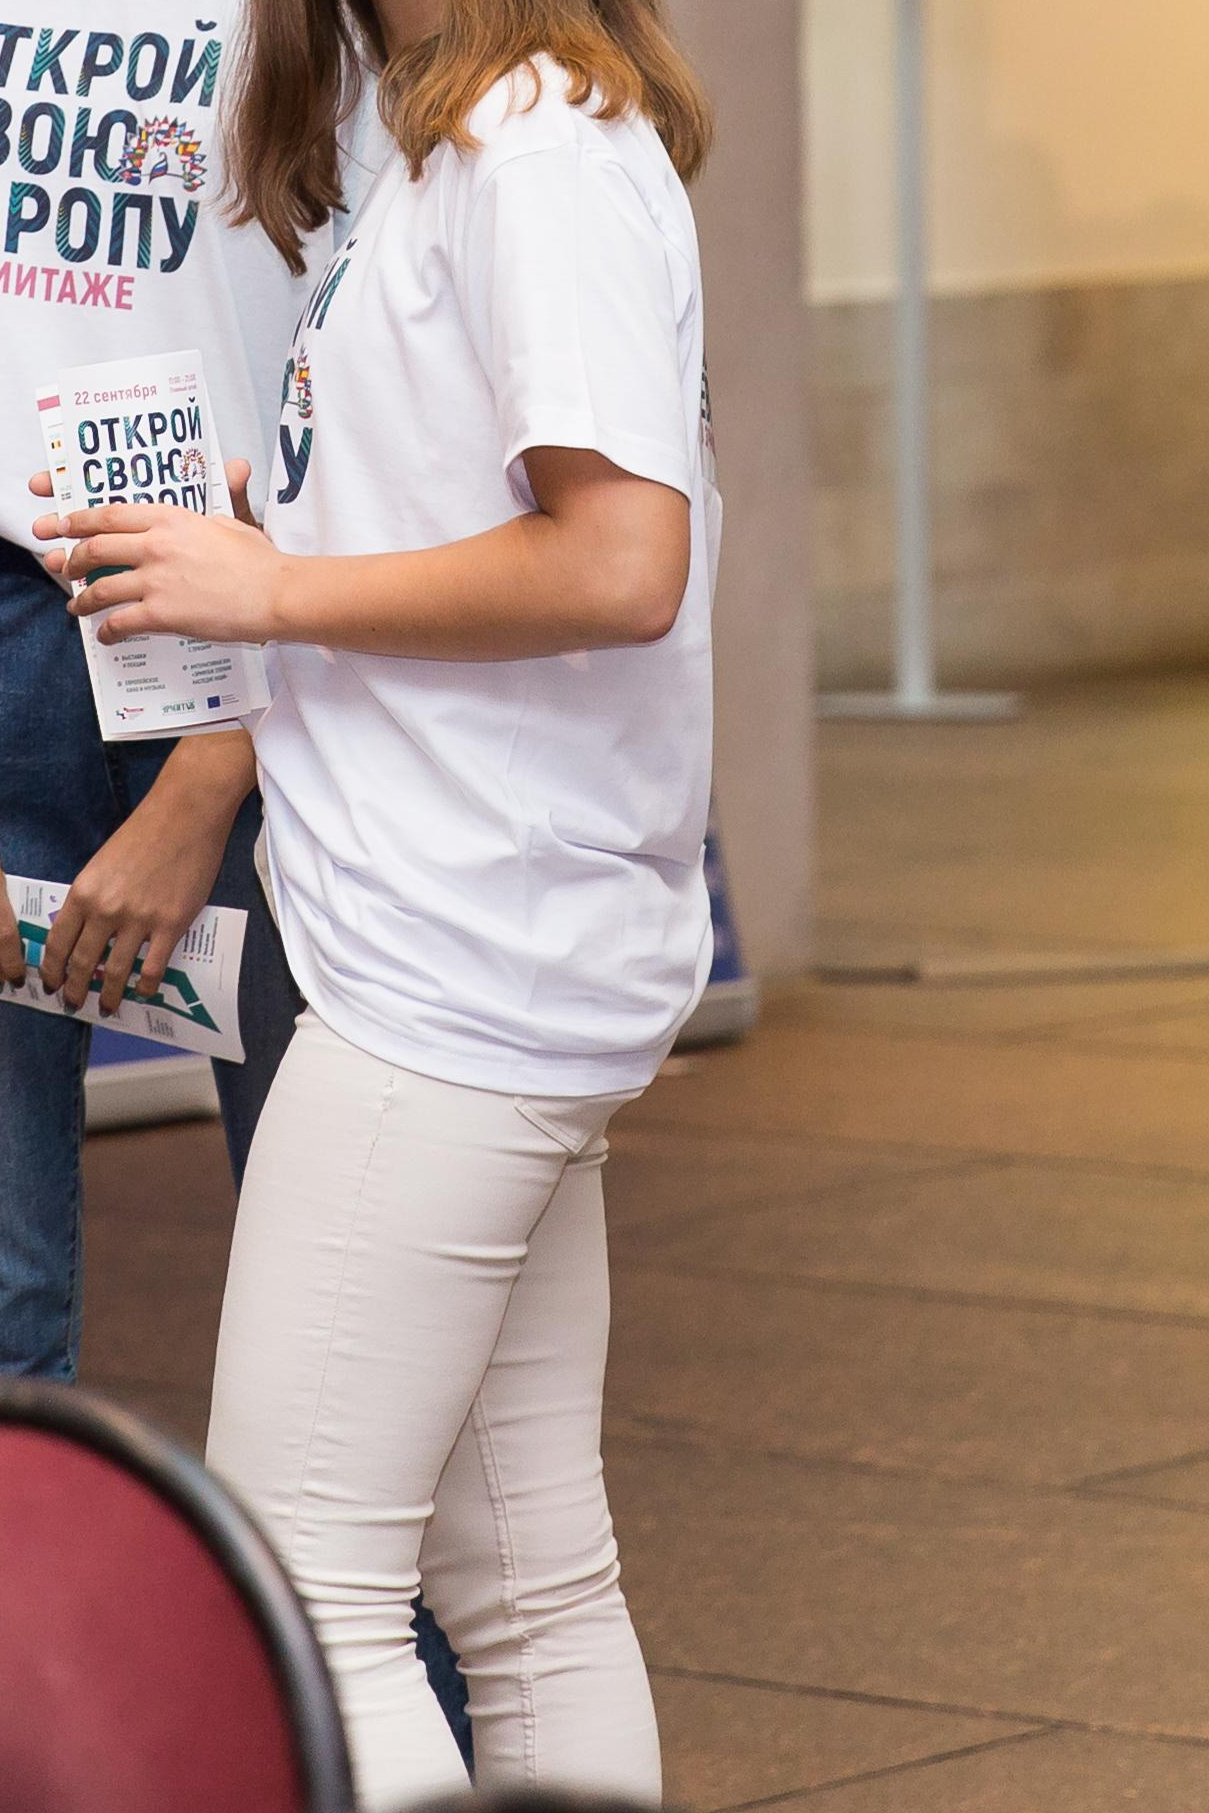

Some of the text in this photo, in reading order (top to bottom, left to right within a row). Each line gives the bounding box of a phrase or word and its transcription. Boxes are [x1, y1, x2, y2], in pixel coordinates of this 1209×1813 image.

[74, 391, 90, 405] 22
[94, 384, 158, 403] сентября
[77, 396, 203, 456] ОТКРОЙ
[83, 448, 182, 494] СВОЮ
